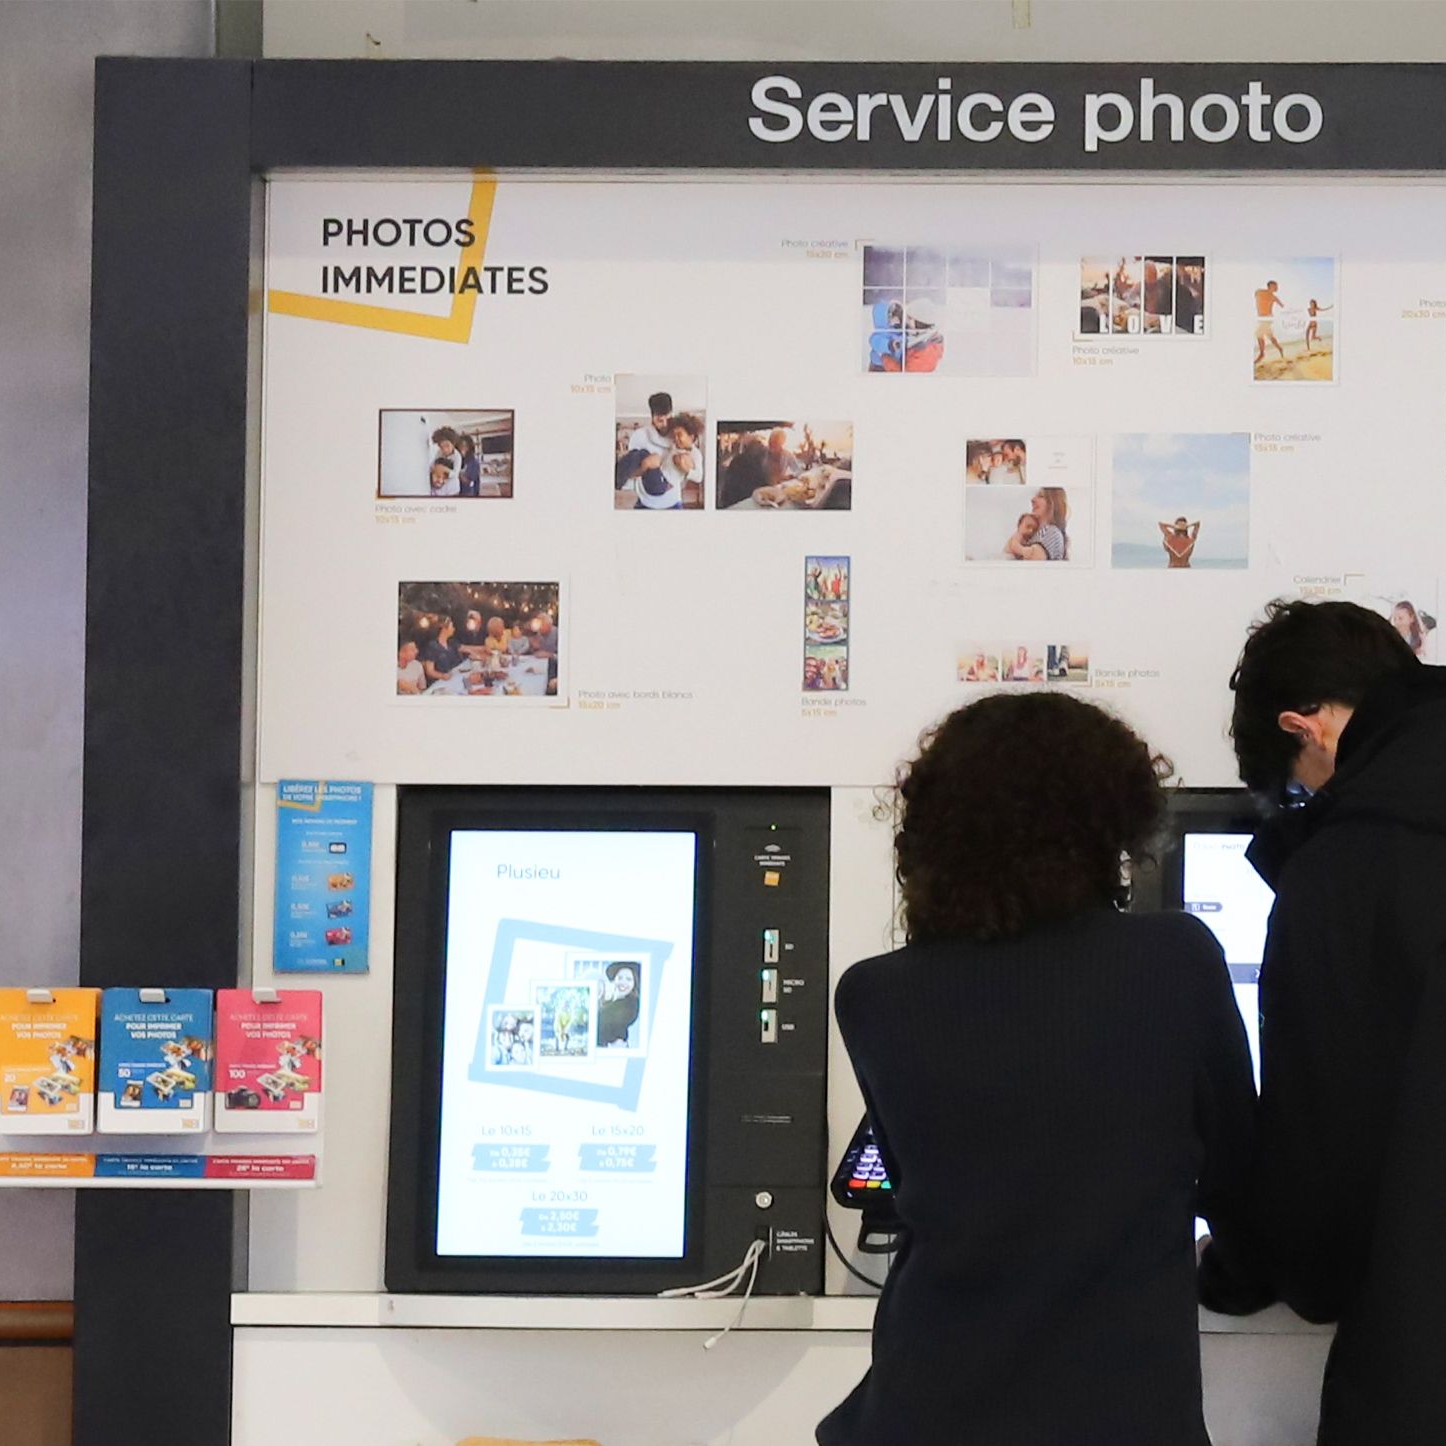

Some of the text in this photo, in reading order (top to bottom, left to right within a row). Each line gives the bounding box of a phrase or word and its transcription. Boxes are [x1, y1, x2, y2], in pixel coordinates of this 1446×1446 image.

[748, 74, 1325, 152] Service photo
[321, 217, 476, 248] PHOTOS
[781, 239, 809, 248] Photo
[835, 250, 849, 258] cm
[321, 265, 550, 297] IMMEDIATES
[1419, 299, 1446, 308] Photo
[1431, 310, 1446, 319] cm
[1071, 346, 1100, 355] Photo
[1098, 357, 1114, 366] cm
[584, 373, 612, 382] Photo
[597, 384, 612, 393] cm
[1253, 433, 1282, 442] Photo
[1279, 444, 1295, 452] cm
[374, 504, 402, 513] Photo
[404, 505, 427, 513] avec
[401, 515, 417, 524] cm
[1095, 668, 1160, 679] Bande photos
[1117, 680, 1132, 688] cm
[578, 690, 606, 699] Photo
[607, 691, 630, 699] avec
[606, 701, 621, 710] cm
[801, 697, 867, 708] Bande photos
[823, 708, 837, 717] cm
[330, 785, 362, 795] PHOTOS
[496, 863, 561, 880] Plusieu
[114, 1013, 194, 1022] ACHETEZ CETTE CARTE
[125, 1022, 182, 1031] POUR IMPRIMER
[130, 1031, 177, 1039] VOS PHOTOS
[228, 1069, 247, 1079] 100
[481, 1124, 532, 1137] Le 10x15
[591, 1124, 645, 1137] Le 15x20
[531, 1189, 588, 1202] Le 20x30
